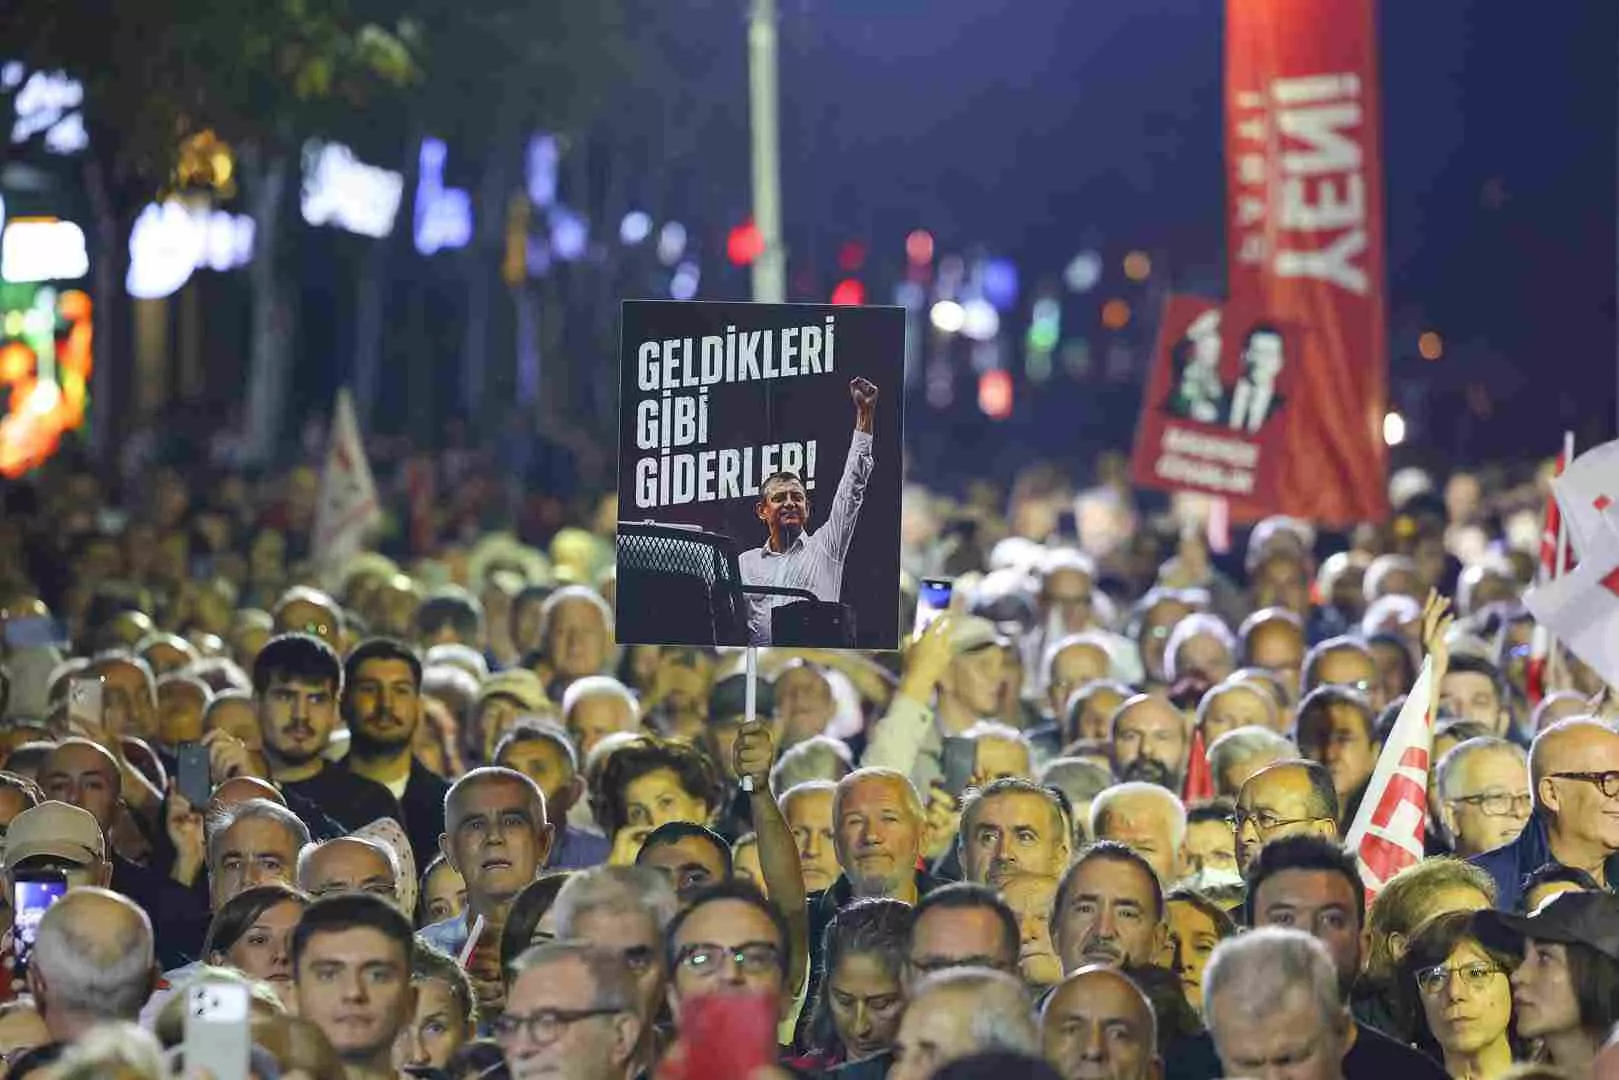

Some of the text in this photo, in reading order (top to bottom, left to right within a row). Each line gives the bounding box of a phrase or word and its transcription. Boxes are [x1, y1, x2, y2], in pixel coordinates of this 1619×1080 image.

[638, 316, 834, 391] GELDİKLERİ
[637, 387, 709, 449] GİBİ
[635, 441, 817, 508] GİDERLER!
